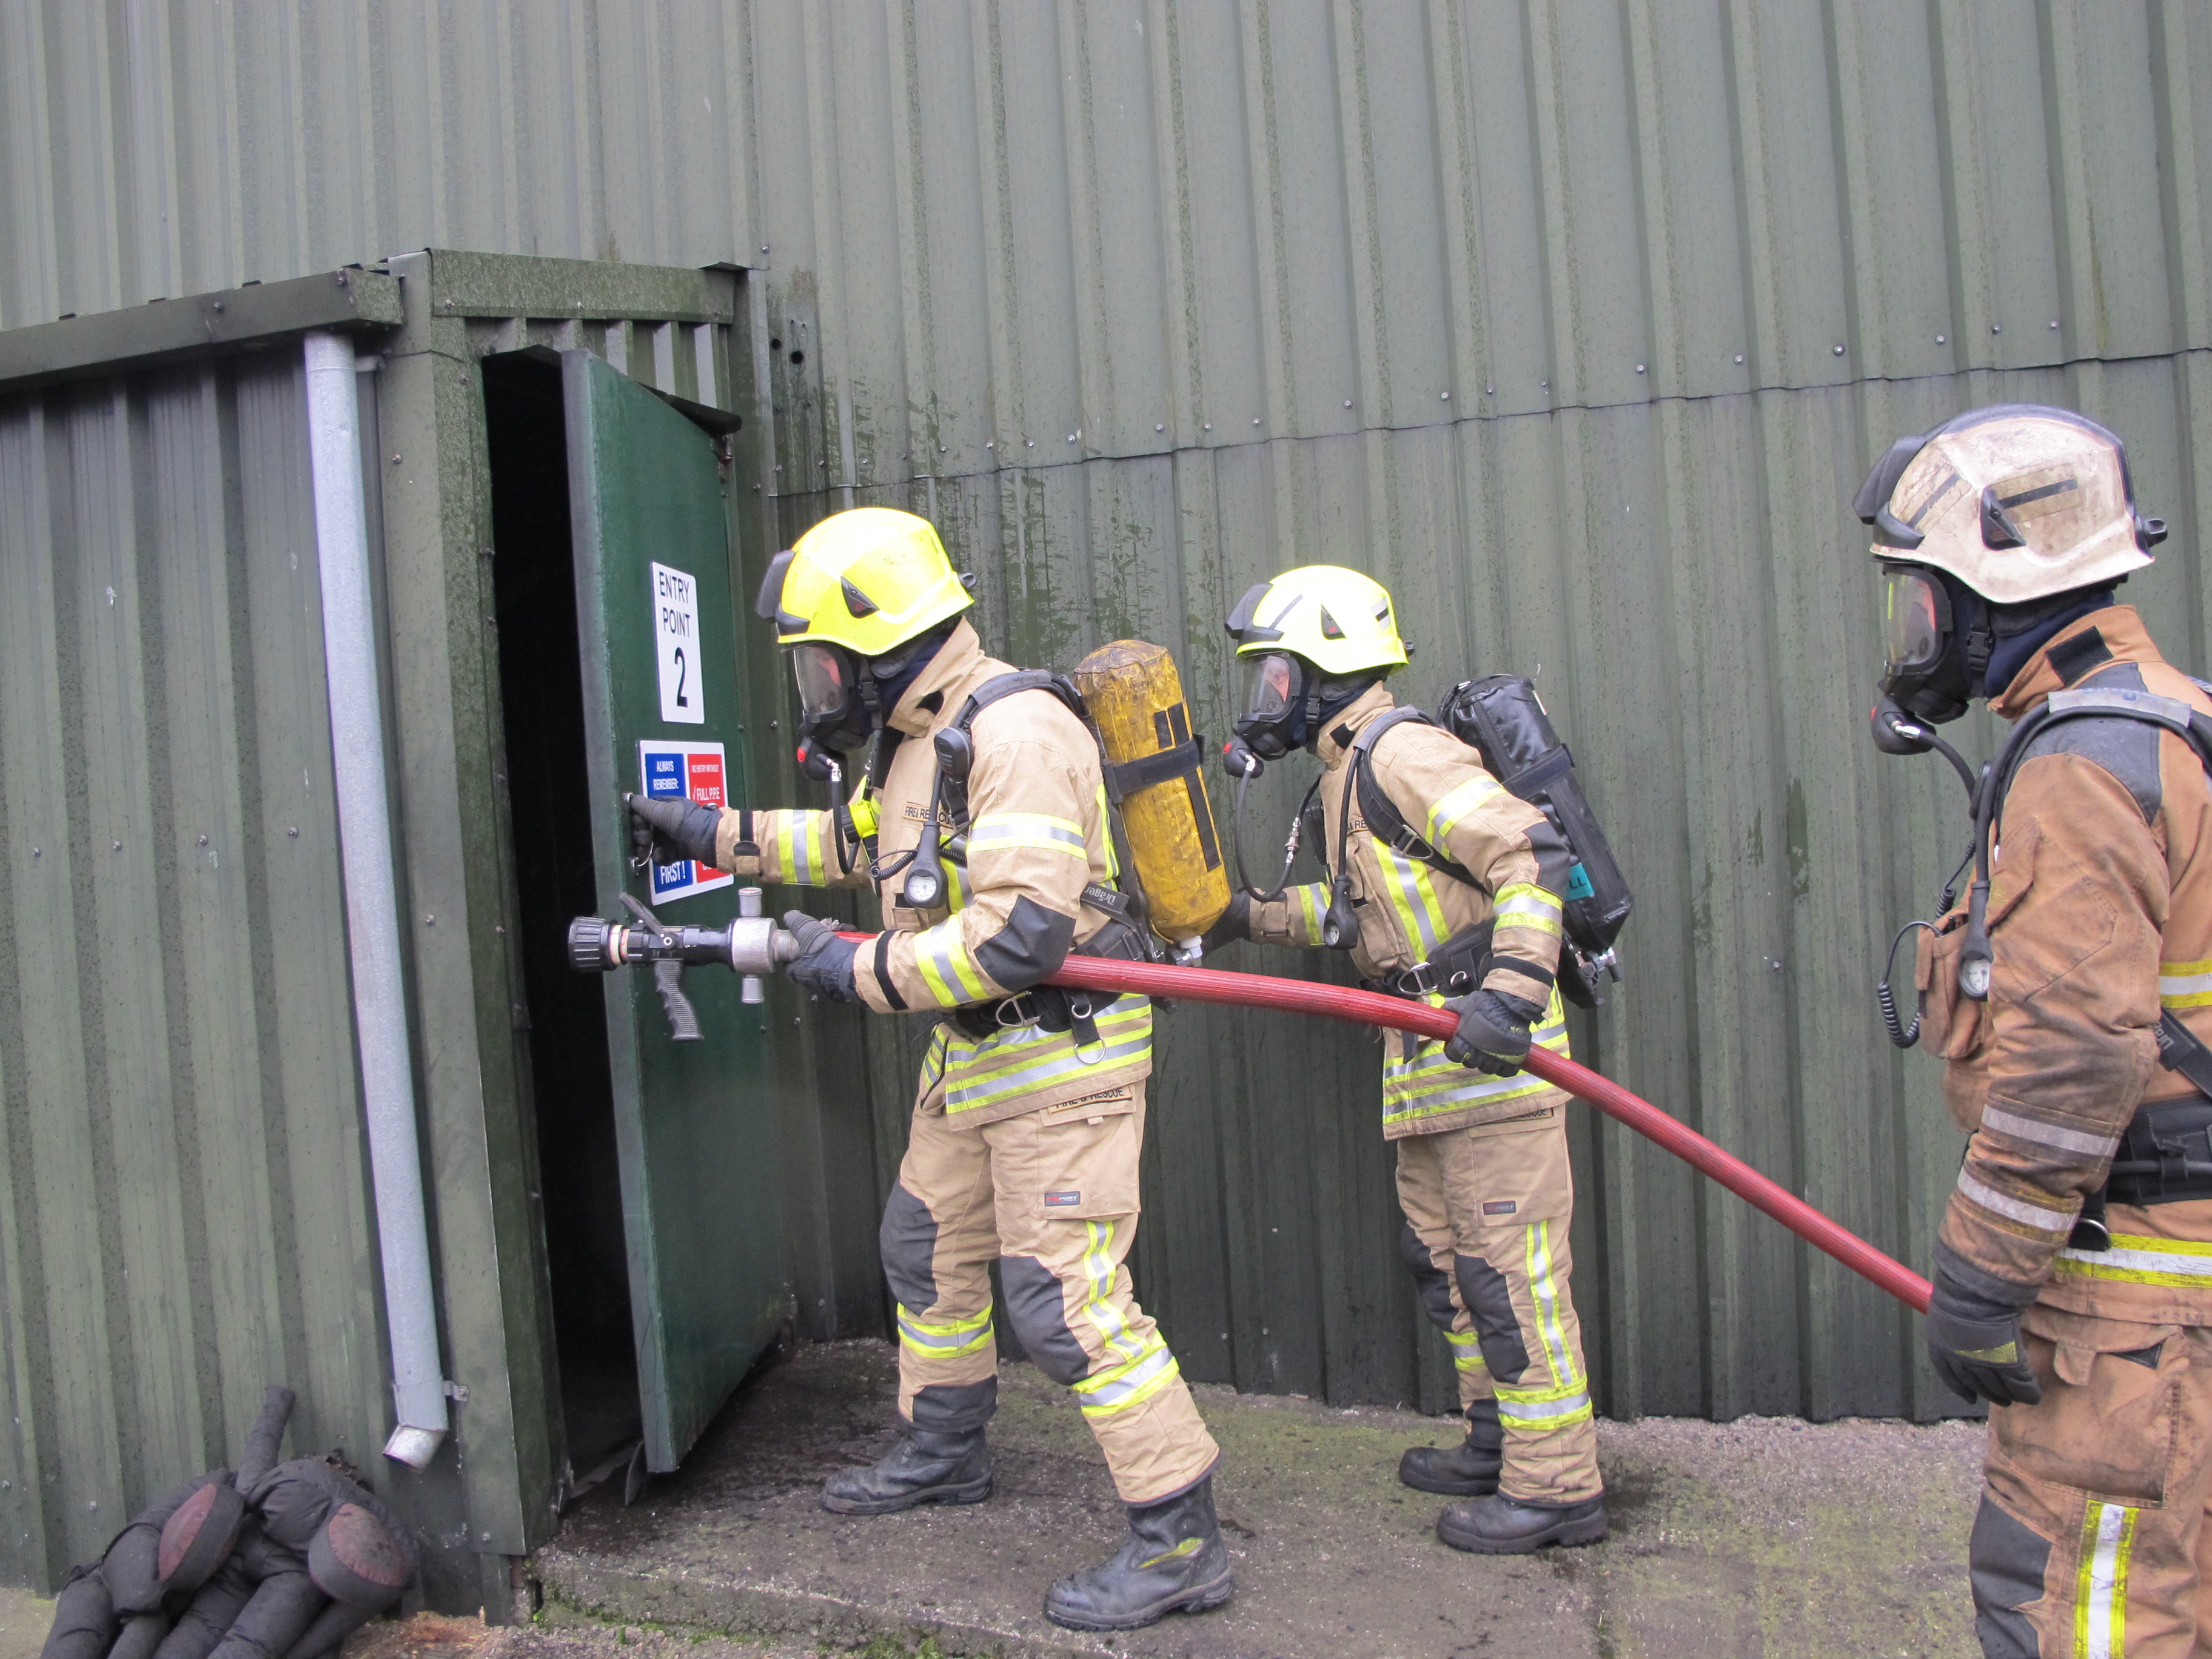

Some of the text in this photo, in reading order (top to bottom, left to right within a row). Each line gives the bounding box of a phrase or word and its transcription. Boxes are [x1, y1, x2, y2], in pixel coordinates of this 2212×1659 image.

[659, 571, 689, 605] ENTRY
[663, 607, 691, 637] POINT
[674, 647, 688, 708] 2
[657, 760, 674, 772] ALWAYS
[697, 788, 709, 801] FULL
[1084, 885, 1116, 905] Dräger
